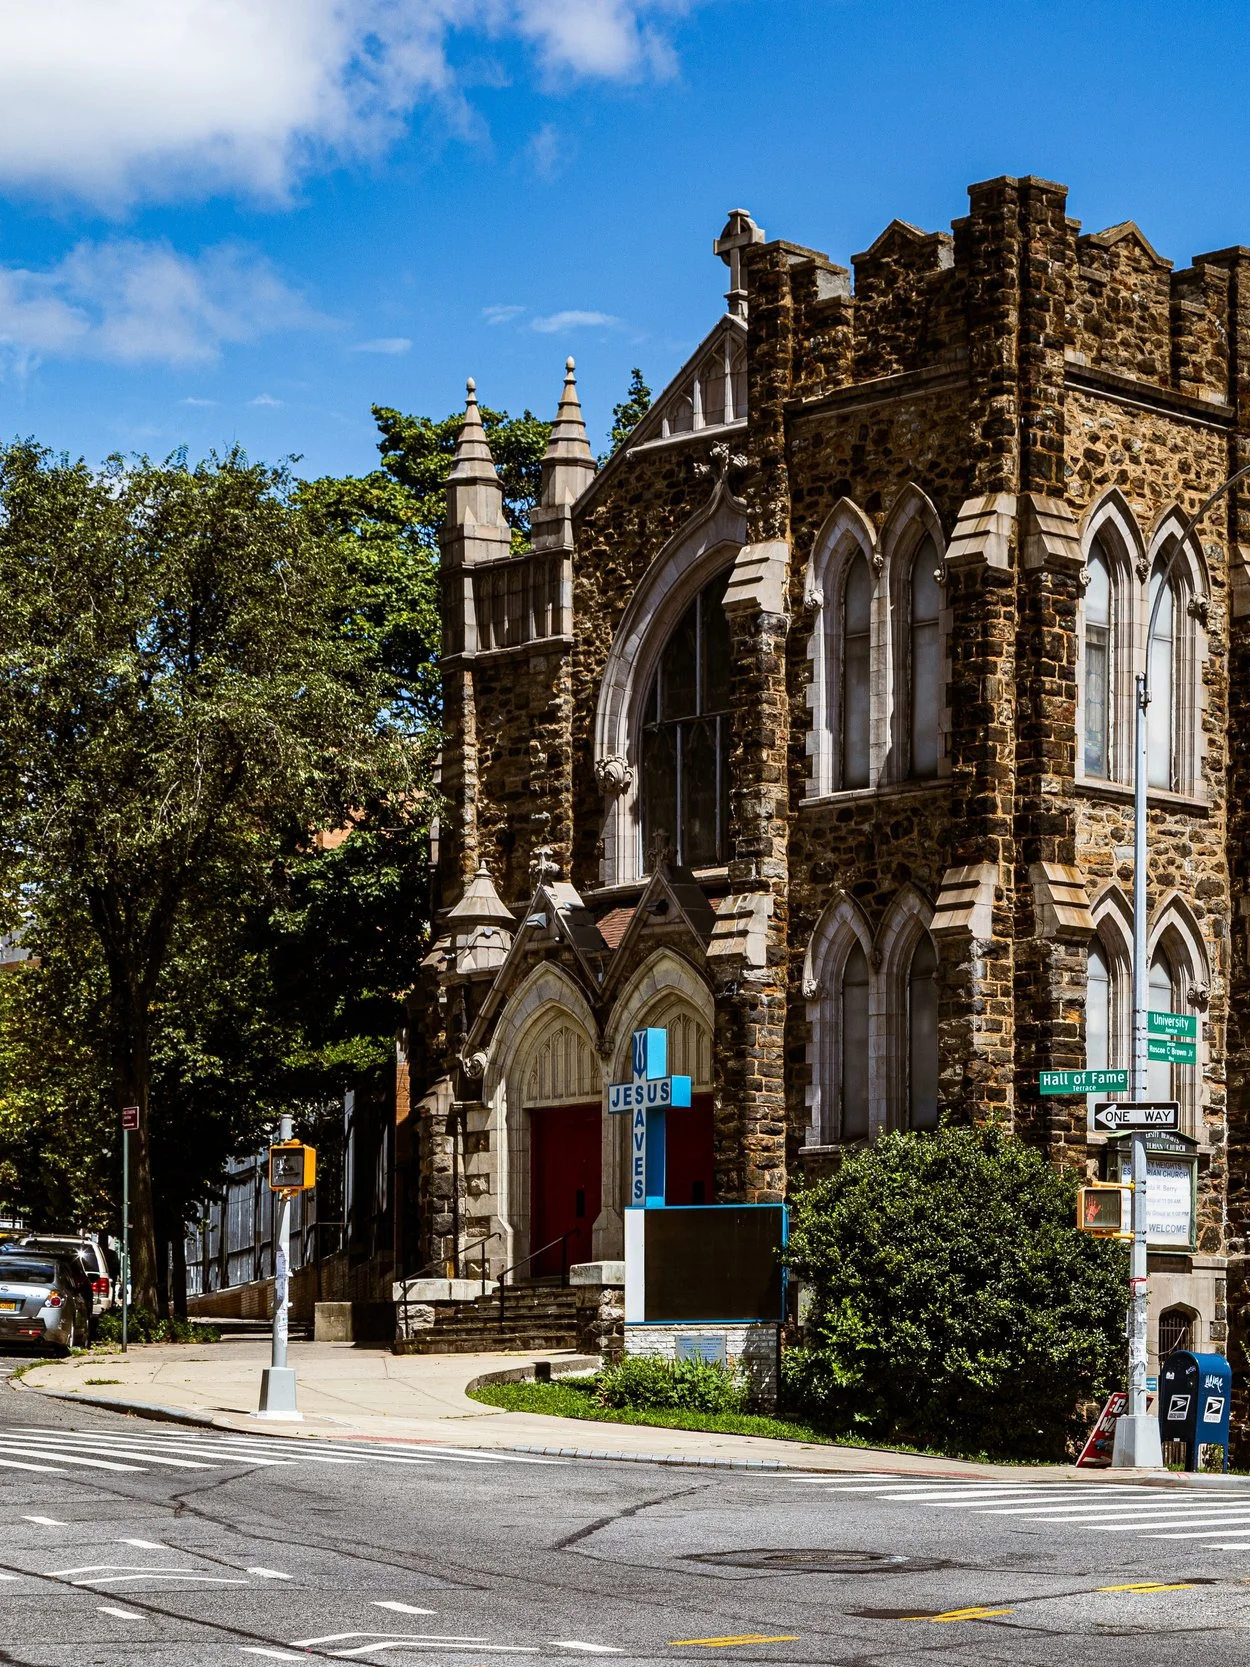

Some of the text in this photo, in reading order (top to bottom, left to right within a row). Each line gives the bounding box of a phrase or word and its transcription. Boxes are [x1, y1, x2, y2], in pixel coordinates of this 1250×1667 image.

[1153, 1013, 1189, 1031] University
[1149, 1045, 1193, 1057] Roscoe C Brown Jr
[1043, 1072, 1125, 1086] Hall of Fame
[612, 1082, 670, 1107] JESUS
[1105, 1111, 1171, 1122] ONE WAY
[1166, 1143, 1186, 1152] CHURCH
[1155, 1160, 1182, 1170] HEIGHTS
[1162, 1169, 1189, 1179] CHURCH
[1148, 1223, 1187, 1234] WELCOME
